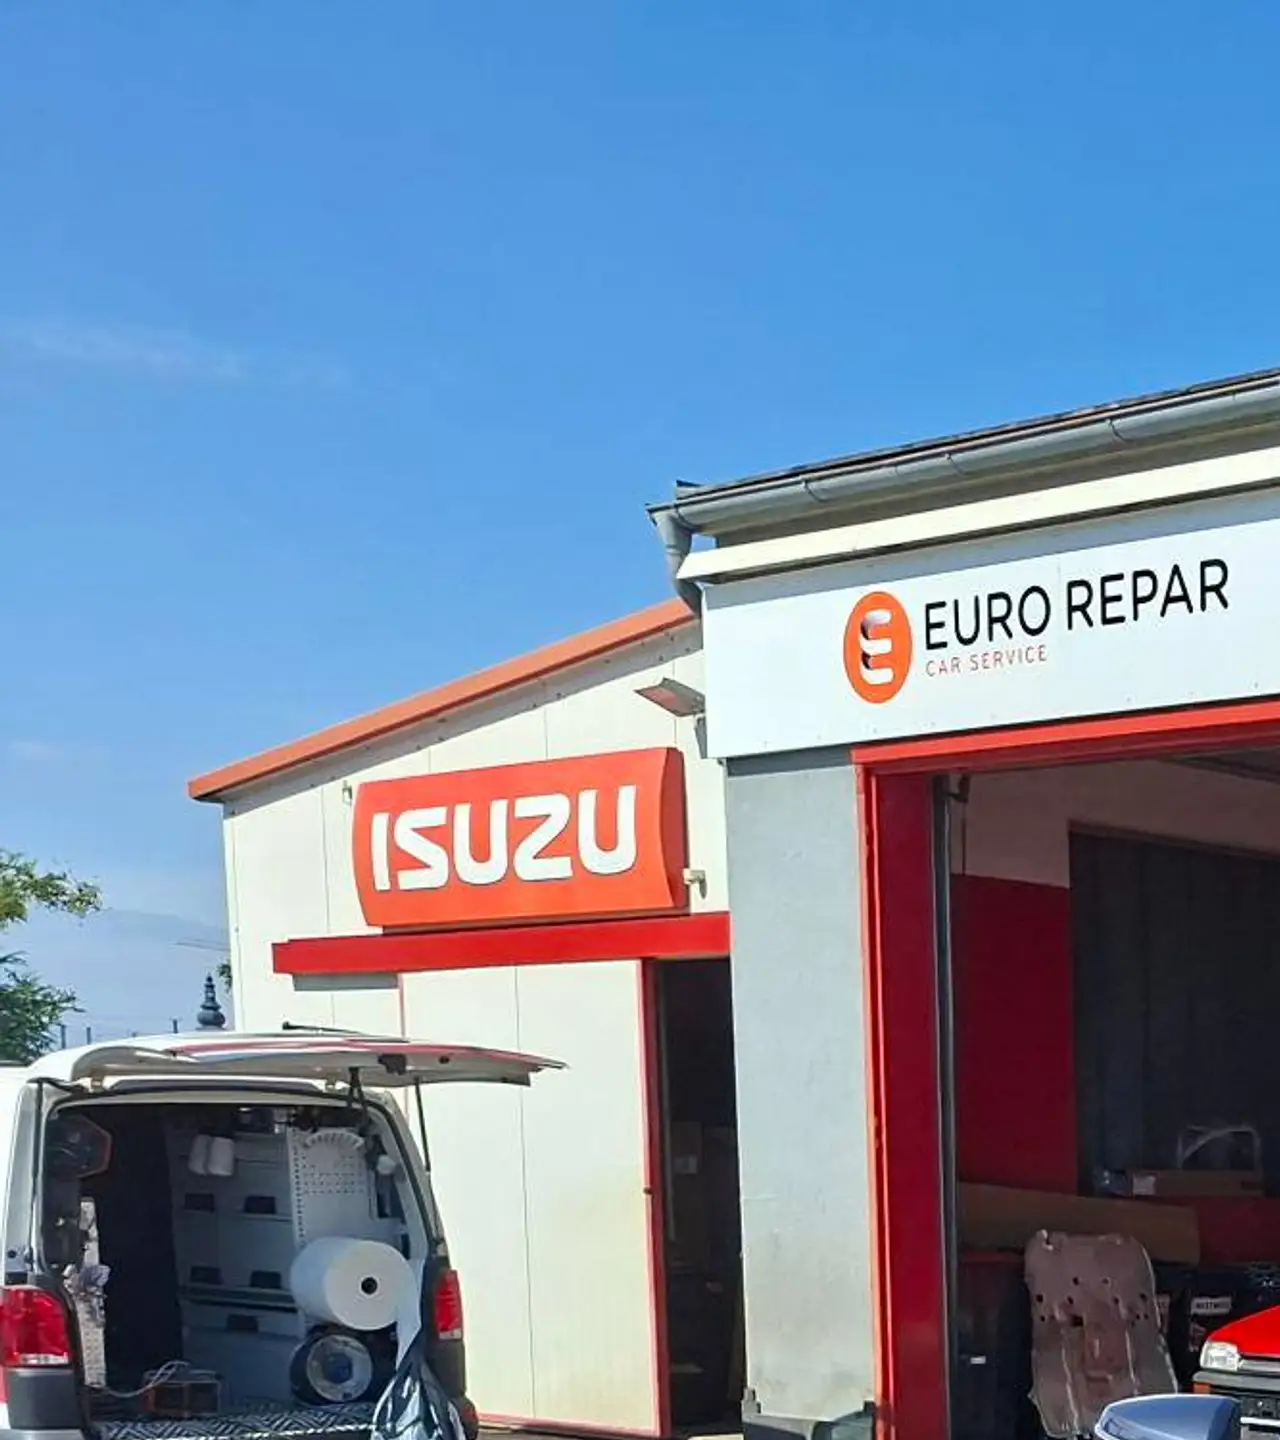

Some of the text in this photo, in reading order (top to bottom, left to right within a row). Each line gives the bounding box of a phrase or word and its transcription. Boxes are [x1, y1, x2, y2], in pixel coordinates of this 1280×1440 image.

[924, 558, 1230, 651] EURO REPAR
[925, 644, 1049, 678] CAR SERVICE
[371, 784, 638, 892] ISUZU
